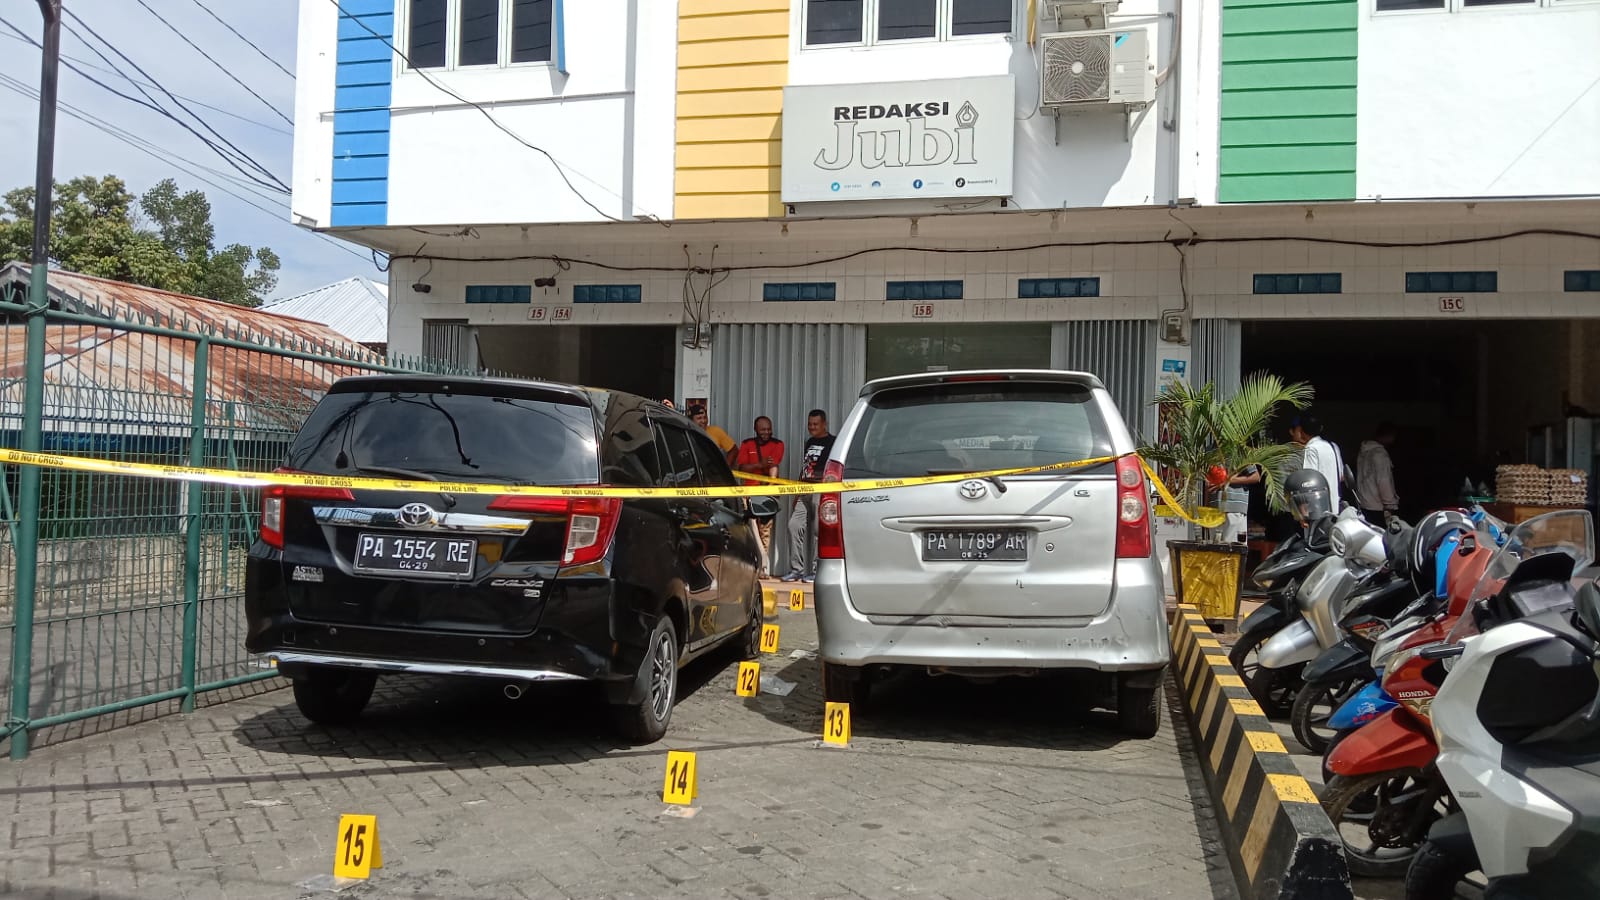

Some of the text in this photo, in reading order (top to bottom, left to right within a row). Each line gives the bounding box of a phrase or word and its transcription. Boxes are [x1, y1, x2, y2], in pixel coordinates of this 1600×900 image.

[834, 101, 949, 120] REDAKSI
[814, 102, 979, 170] Jubi
[555, 308, 569, 319] 15A
[915, 305, 932, 316] 15B
[1442, 299, 1463, 310] 15C
[531, 309, 543, 319] 15
[8, 451, 65, 466] DO NOT CROSS
[362, 537, 470, 562] PA 1554 RE
[927, 532, 1025, 550] PA 1789 AR
[791, 593, 801, 607] 04
[764, 629, 775, 647] 10
[741, 668, 755, 691] 12
[1398, 690, 1431, 698] HONDA
[828, 709, 844, 737] 13
[670, 760, 688, 795] 14
[343, 823, 367, 867] 15
